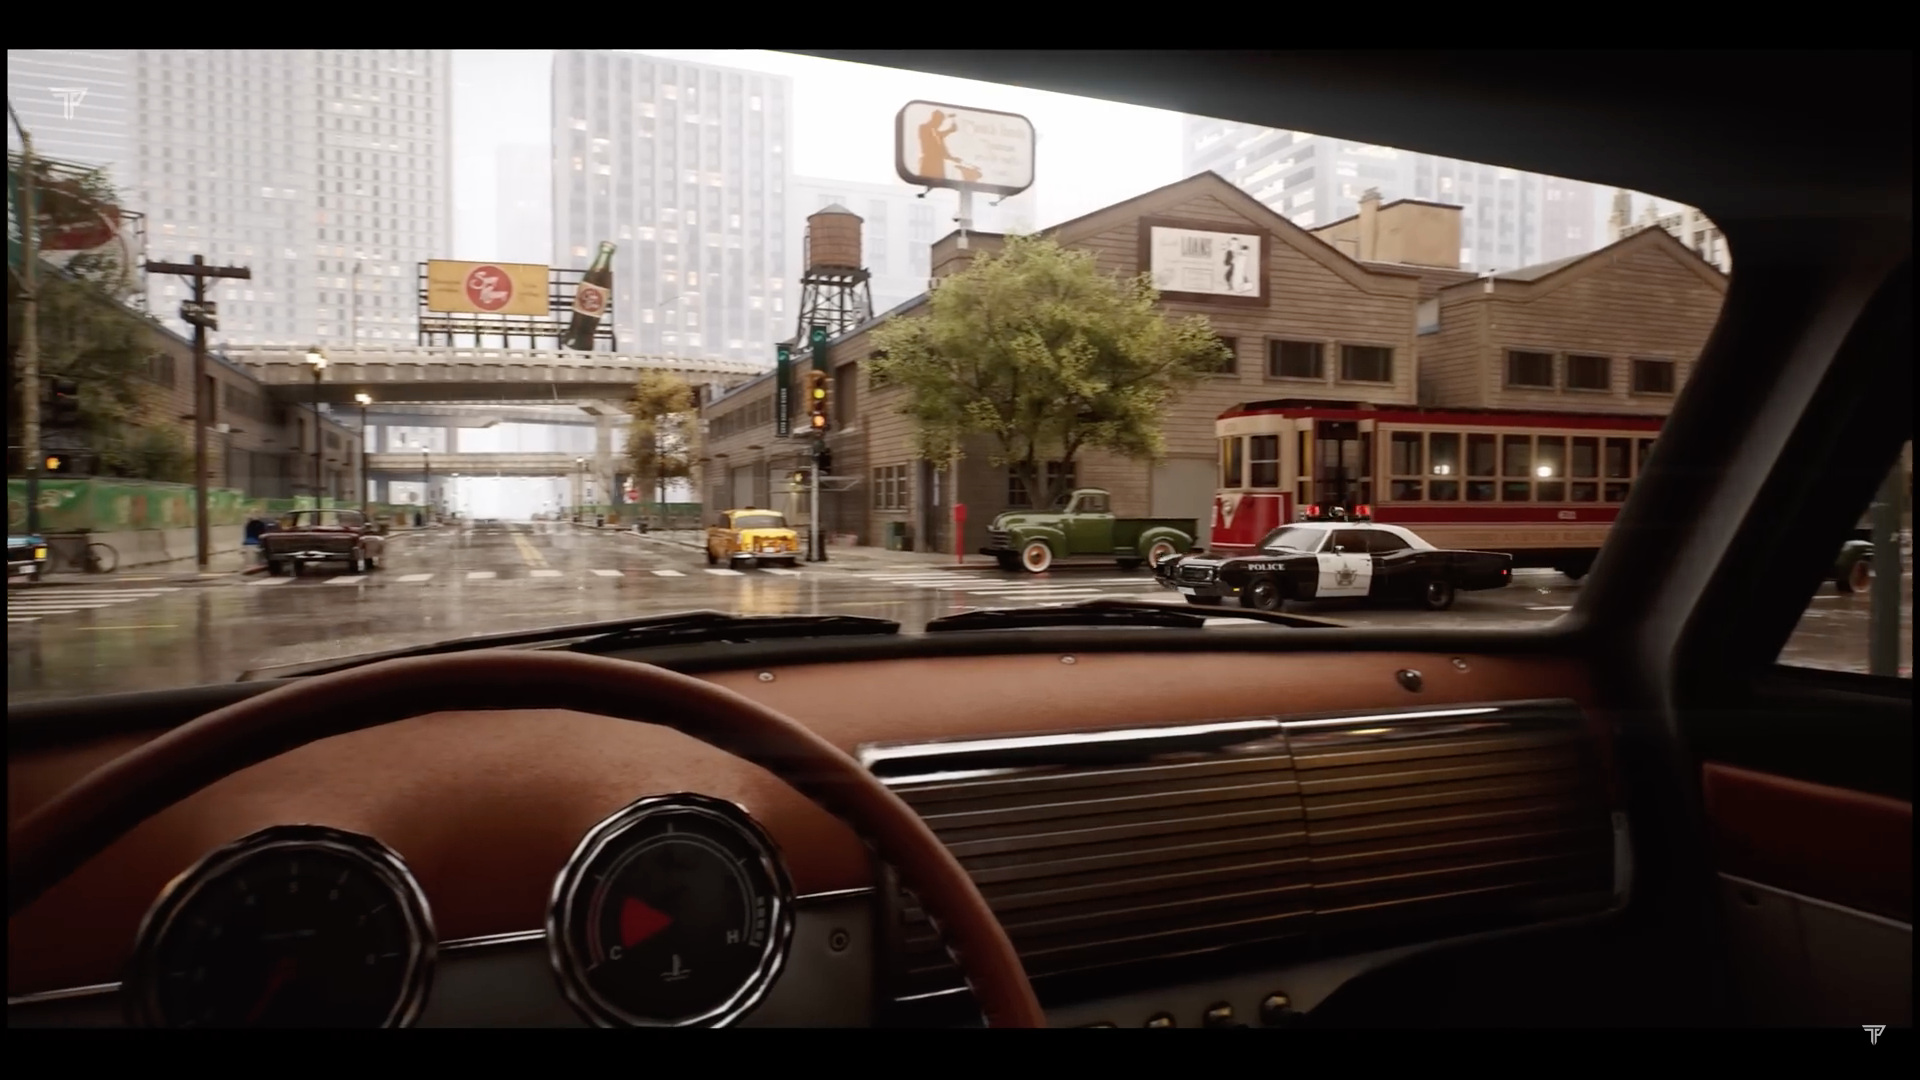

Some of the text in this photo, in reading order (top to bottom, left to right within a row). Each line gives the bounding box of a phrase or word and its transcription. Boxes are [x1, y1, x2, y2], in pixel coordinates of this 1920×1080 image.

[1180, 236, 1213, 258] LOANS
[1248, 563, 1286, 571] POLICE
[726, 930, 739, 944] H
[609, 945, 622, 960] C
